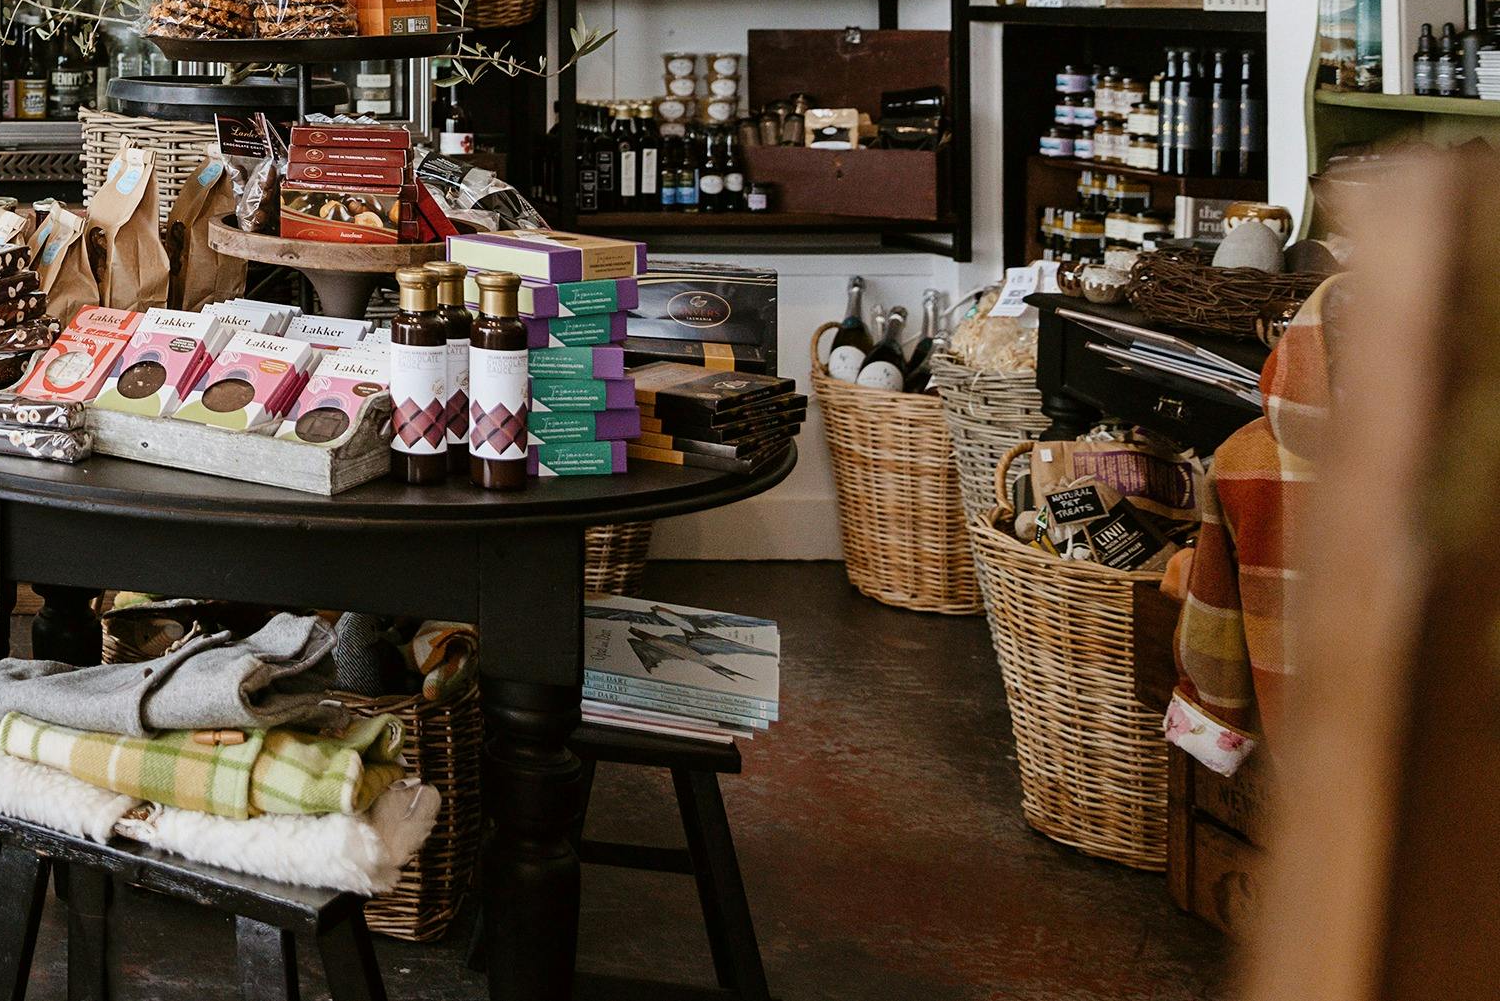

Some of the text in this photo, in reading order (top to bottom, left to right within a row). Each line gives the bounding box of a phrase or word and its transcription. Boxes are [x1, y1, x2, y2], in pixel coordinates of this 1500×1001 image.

[223, 141, 250, 150] CHOCOLATE
[1198, 205, 1223, 219] the
[339, 231, 363, 239] hazelnut
[88, 312, 125, 326] Lakker
[154, 315, 196, 329] Lakker
[219, 313, 251, 326] akker
[301, 325, 345, 337] Lakker
[245, 337, 289, 352] Lakker
[334, 363, 379, 375] Lakker
[486, 359, 527, 368] CHOCOLAT
[1051, 487, 1093, 502] NATURAL
[1059, 498, 1081, 508] PET
[1055, 504, 1095, 519] TREATS
